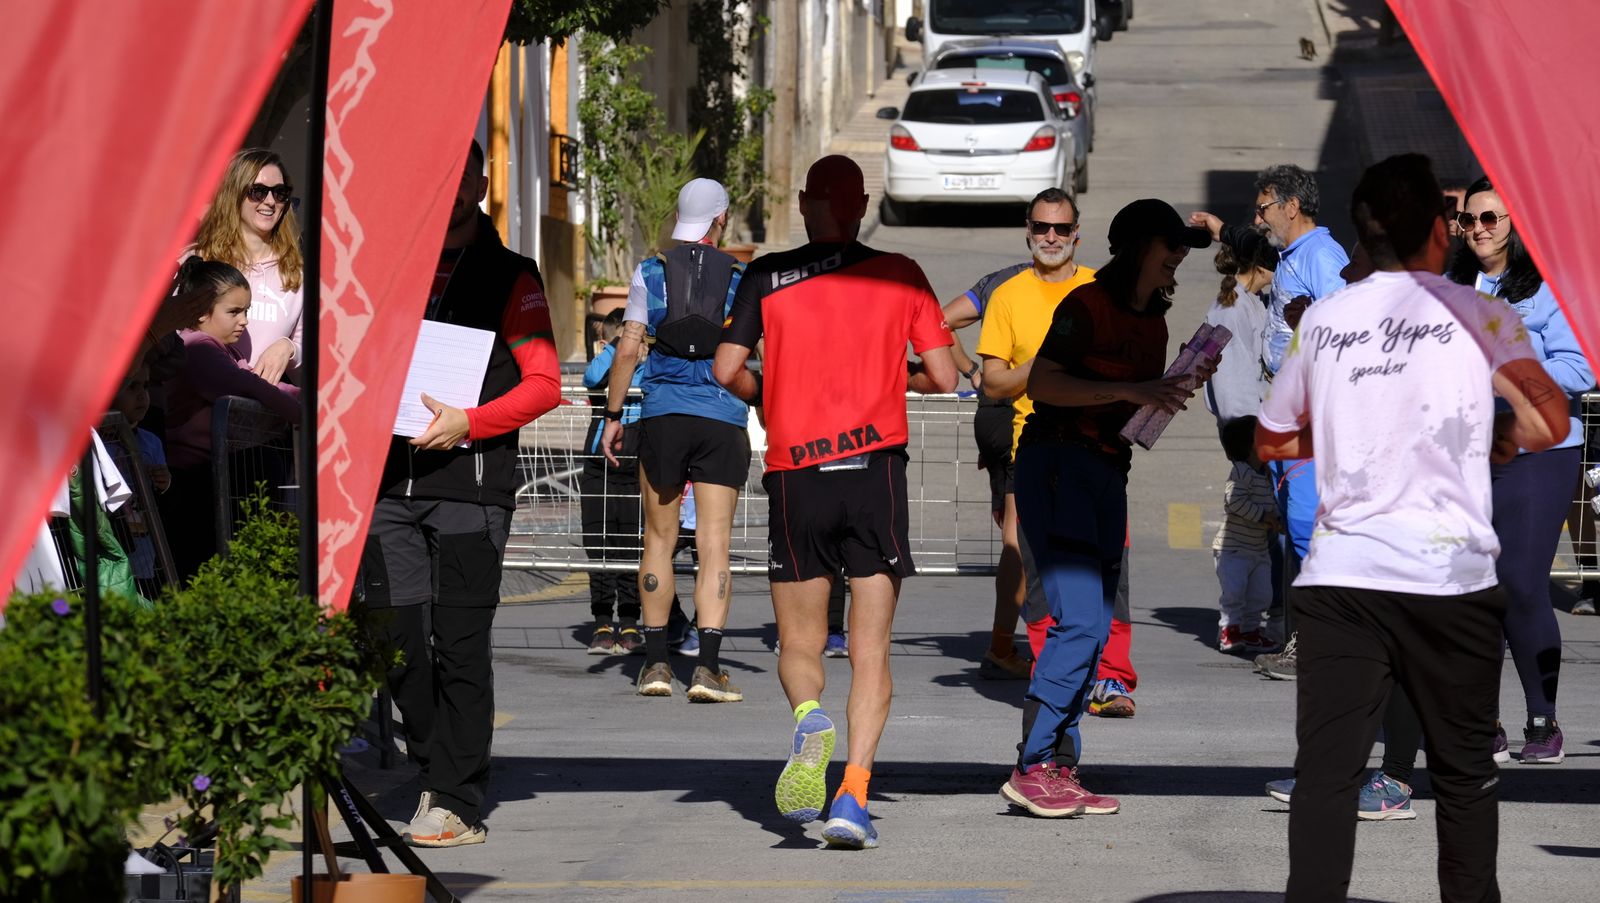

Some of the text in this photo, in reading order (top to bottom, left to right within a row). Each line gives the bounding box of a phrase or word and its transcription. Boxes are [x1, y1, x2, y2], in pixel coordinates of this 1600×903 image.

[771, 252, 842, 289] land
[1311, 316, 1457, 362] Pepe Yepes
[1349, 358, 1408, 386] speaker
[789, 424, 883, 466] PIRATA
